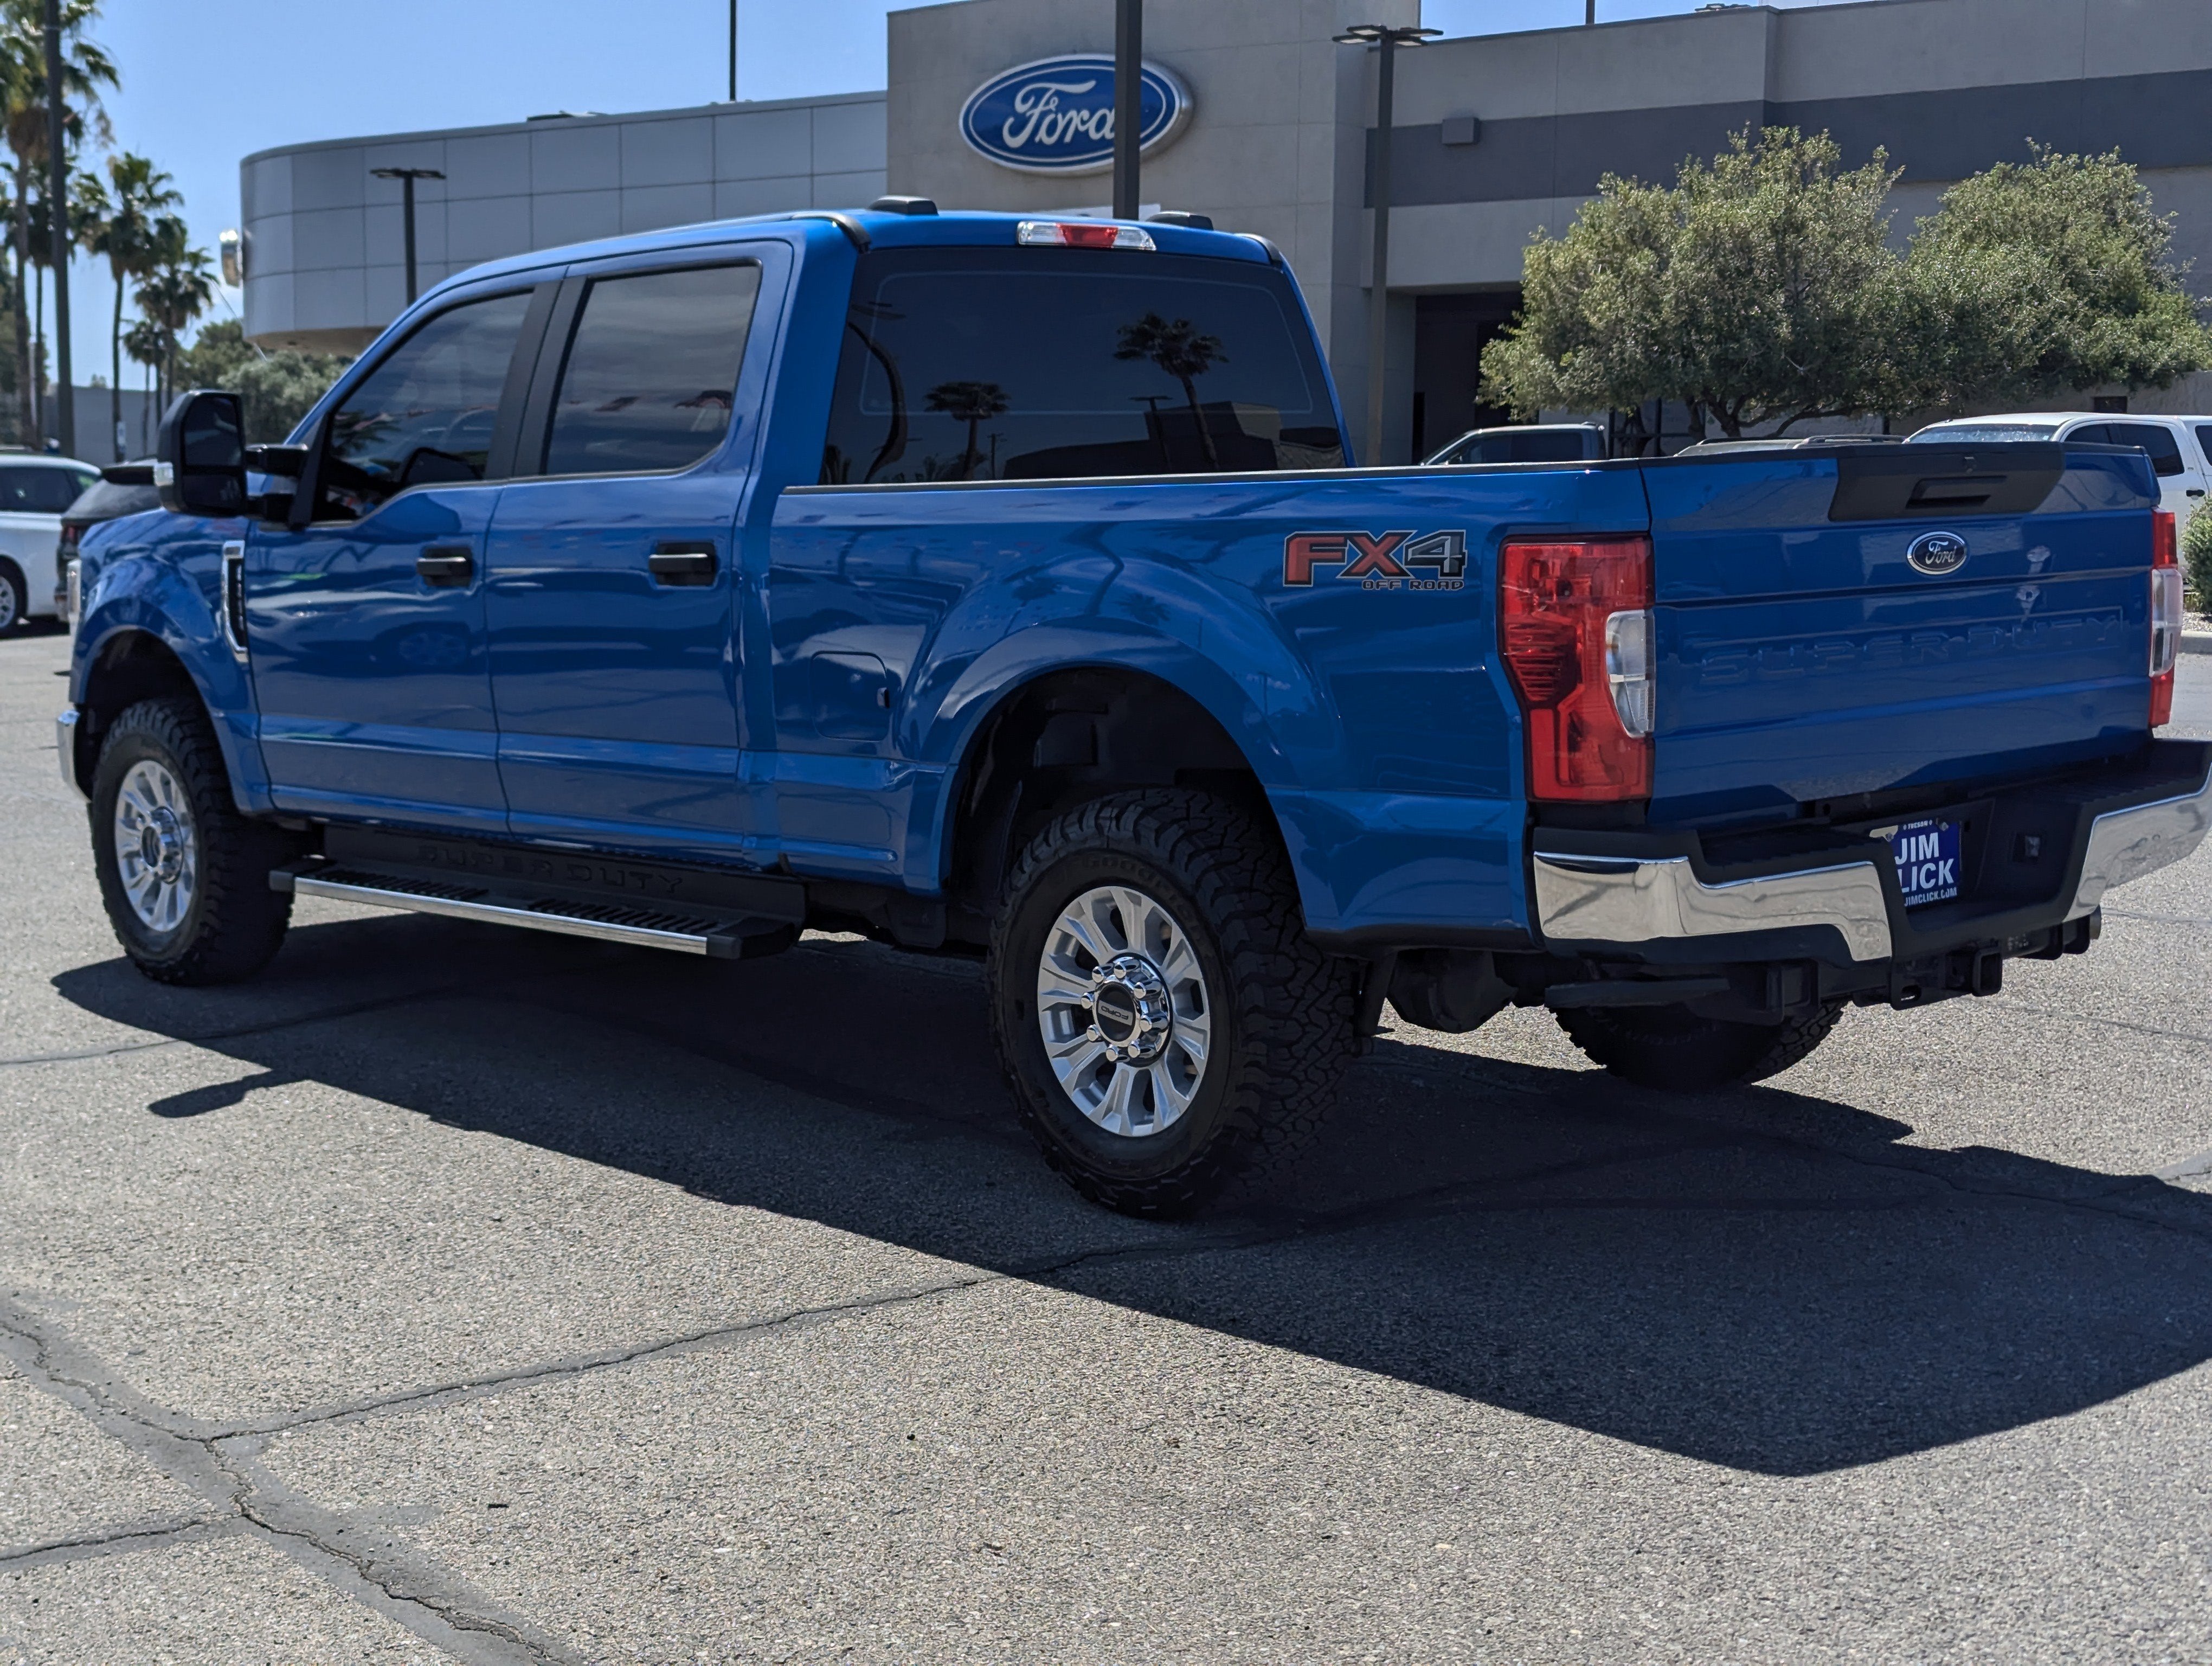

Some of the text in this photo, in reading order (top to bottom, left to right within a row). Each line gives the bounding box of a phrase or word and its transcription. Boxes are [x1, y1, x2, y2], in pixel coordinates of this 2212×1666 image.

[1283, 529, 1468, 587] FX4
[1925, 541, 1957, 565] Ford
[1361, 579, 1465, 591] OFF ROAD
[1894, 832, 1939, 865] JIM
[1897, 858, 1954, 893] LICK
[1904, 887, 1957, 907] JIMCLICK.COM
[1101, 1005, 1129, 1021] FORD
